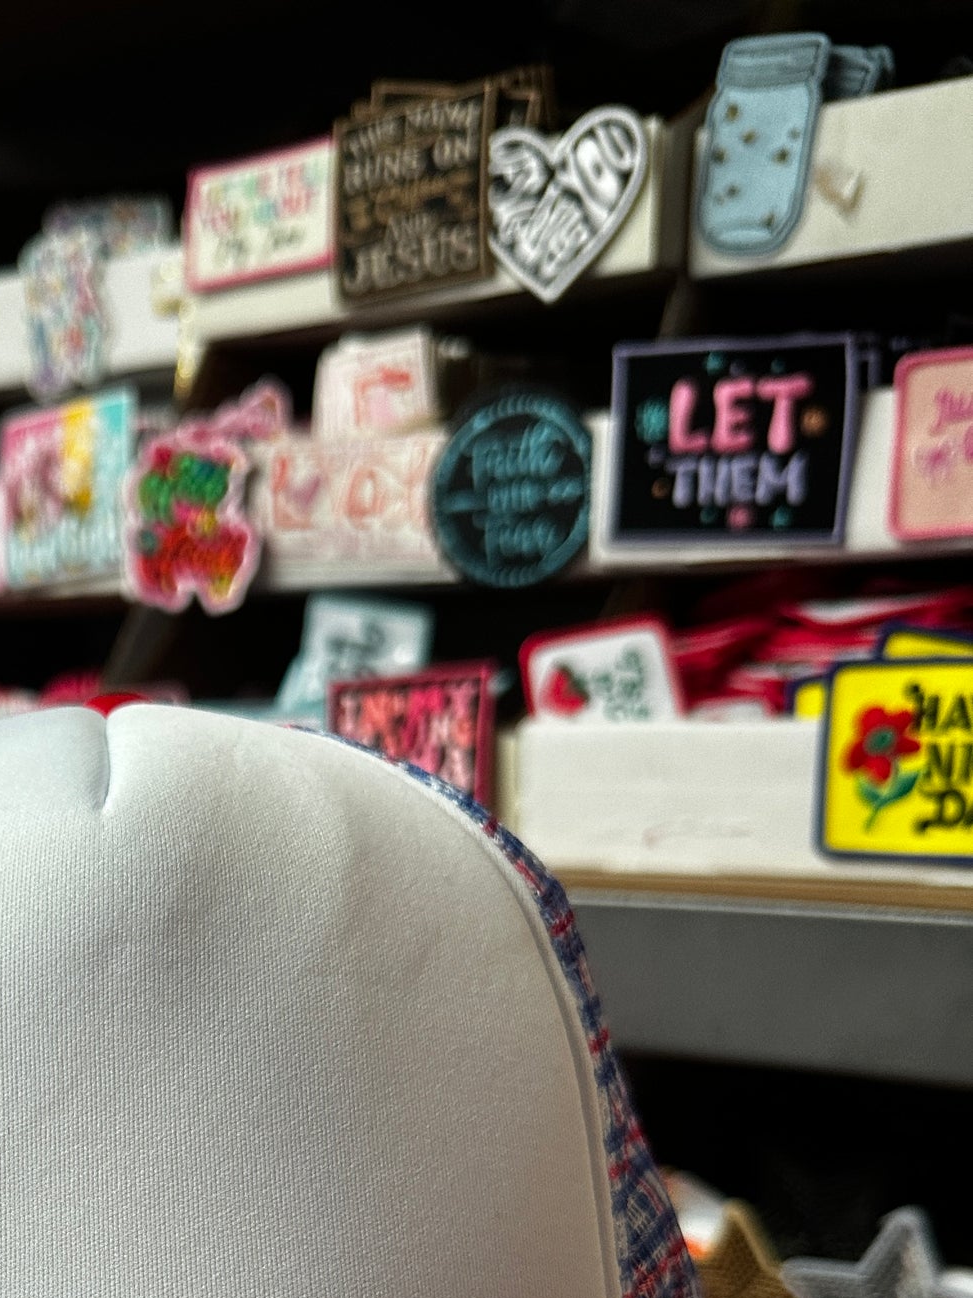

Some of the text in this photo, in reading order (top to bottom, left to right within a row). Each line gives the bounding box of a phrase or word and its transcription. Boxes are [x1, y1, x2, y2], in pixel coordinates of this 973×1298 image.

[432, 132, 479, 169] ON
[343, 225, 479, 294] JESUS
[668, 373, 815, 455] LET
[664, 453, 809, 508] THEM
